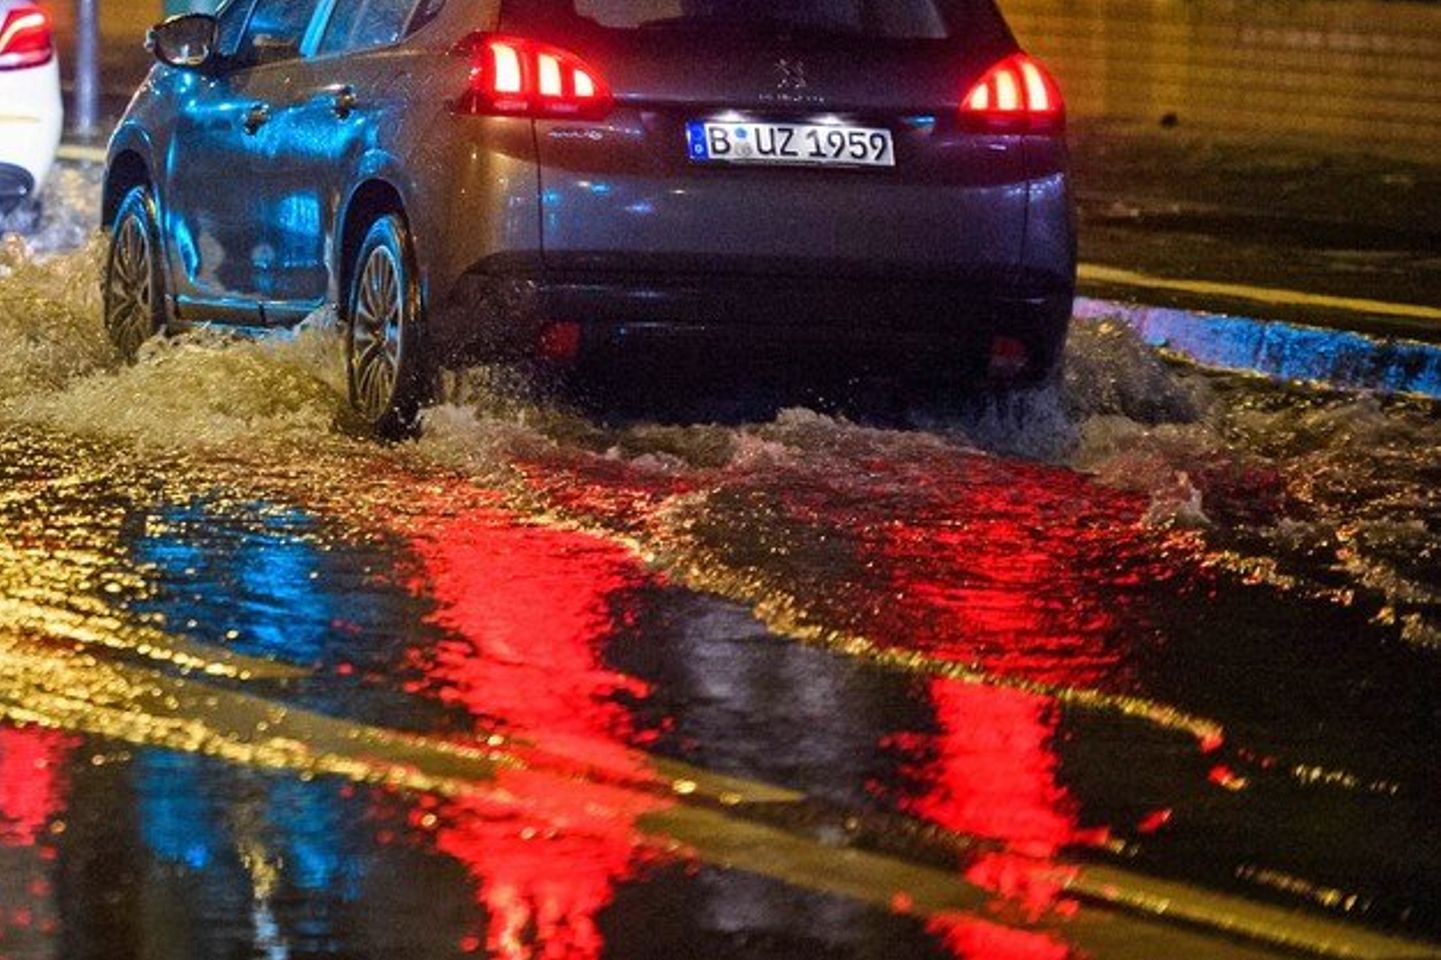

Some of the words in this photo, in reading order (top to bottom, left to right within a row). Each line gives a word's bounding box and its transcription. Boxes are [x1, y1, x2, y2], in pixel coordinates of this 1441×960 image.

[709, 127, 731, 155] B
[755, 127, 798, 157] UZ
[805, 129, 889, 162] 1959
